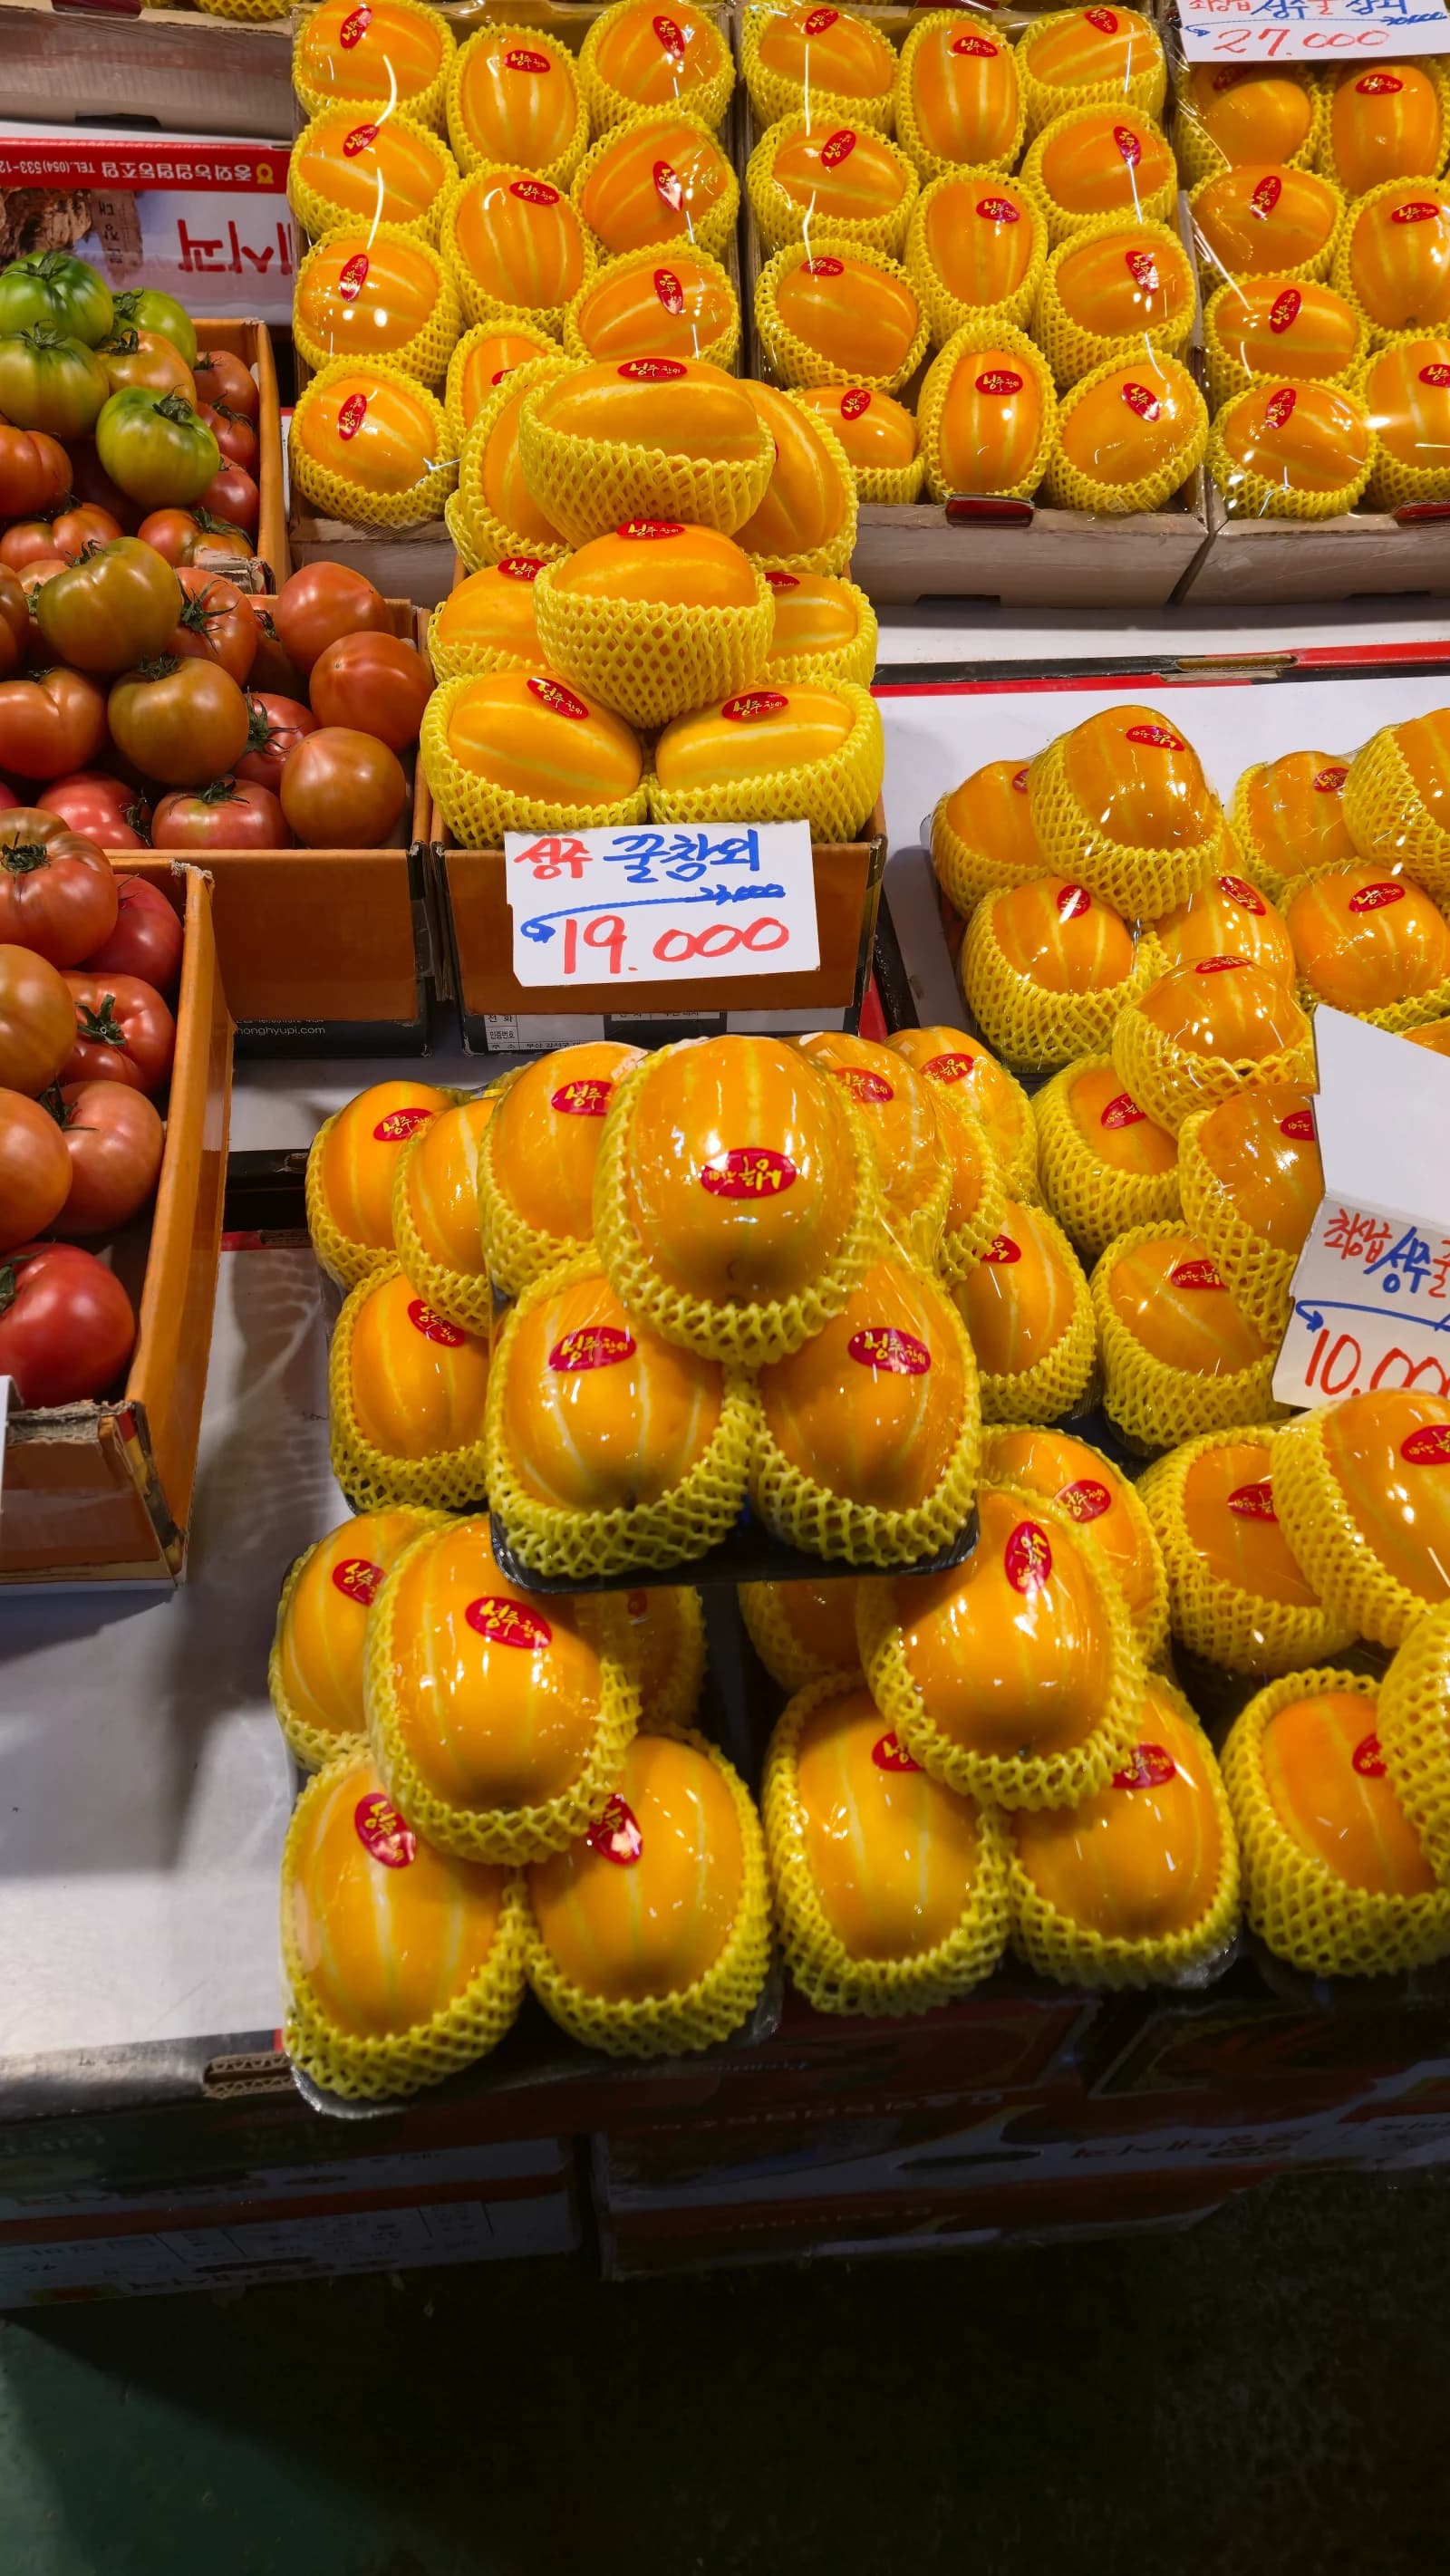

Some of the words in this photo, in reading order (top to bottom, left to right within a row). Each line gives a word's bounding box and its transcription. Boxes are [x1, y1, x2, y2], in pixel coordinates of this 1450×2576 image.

[1213, 28, 1389, 56] 27.000
[629, 363, 660, 378] 성주
[628, 524, 657, 537] 성주
[508, 561, 535, 579] 성주
[733, 700, 763, 717] 성주
[514, 837, 594, 880] 성주
[603, 829, 760, 883] 꿀참외
[563, 915, 789, 974] 19.000
[566, 1085, 603, 1110] 성주
[383, 1115, 412, 1134] 성주
[740, 1156, 782, 1189] 성주
[561, 1336, 595, 1363] 성주
[864, 1335, 904, 1359] 성주
[1306, 1328, 1450, 1398] 10.00
[343, 1562, 372, 1592] 성주
[480, 1600, 520, 1636] 성주
[364, 1800, 397, 1842] 성주
